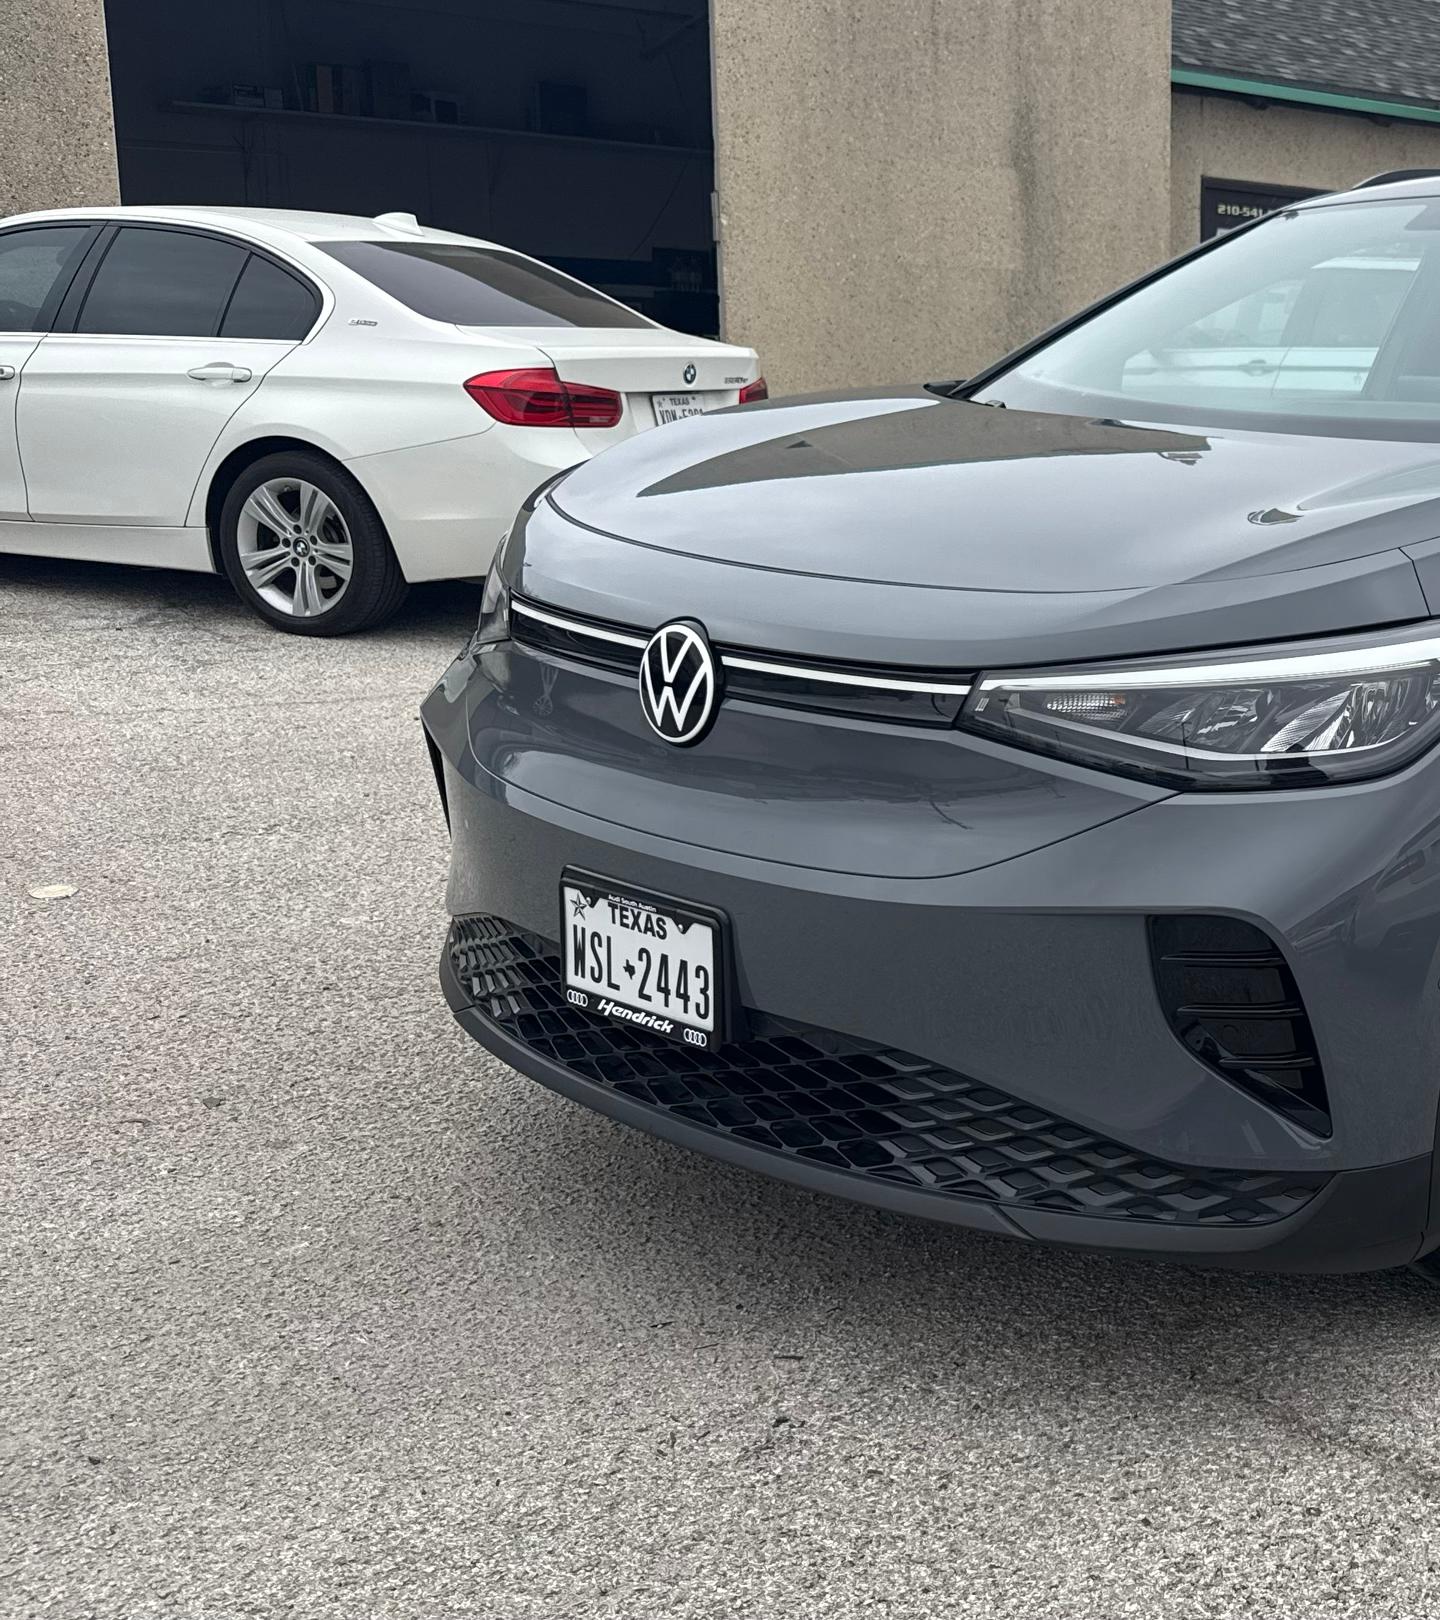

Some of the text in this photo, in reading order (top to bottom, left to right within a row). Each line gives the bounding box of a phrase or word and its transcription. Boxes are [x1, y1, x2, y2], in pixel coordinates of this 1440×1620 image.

[1217, 204, 1272, 218] 210-541
[669, 397, 690, 406] TEXAS
[608, 902, 667, 940] TEXAS
[573, 924, 710, 1020] WSL 2443
[597, 998, 674, 1034] Hendrick
